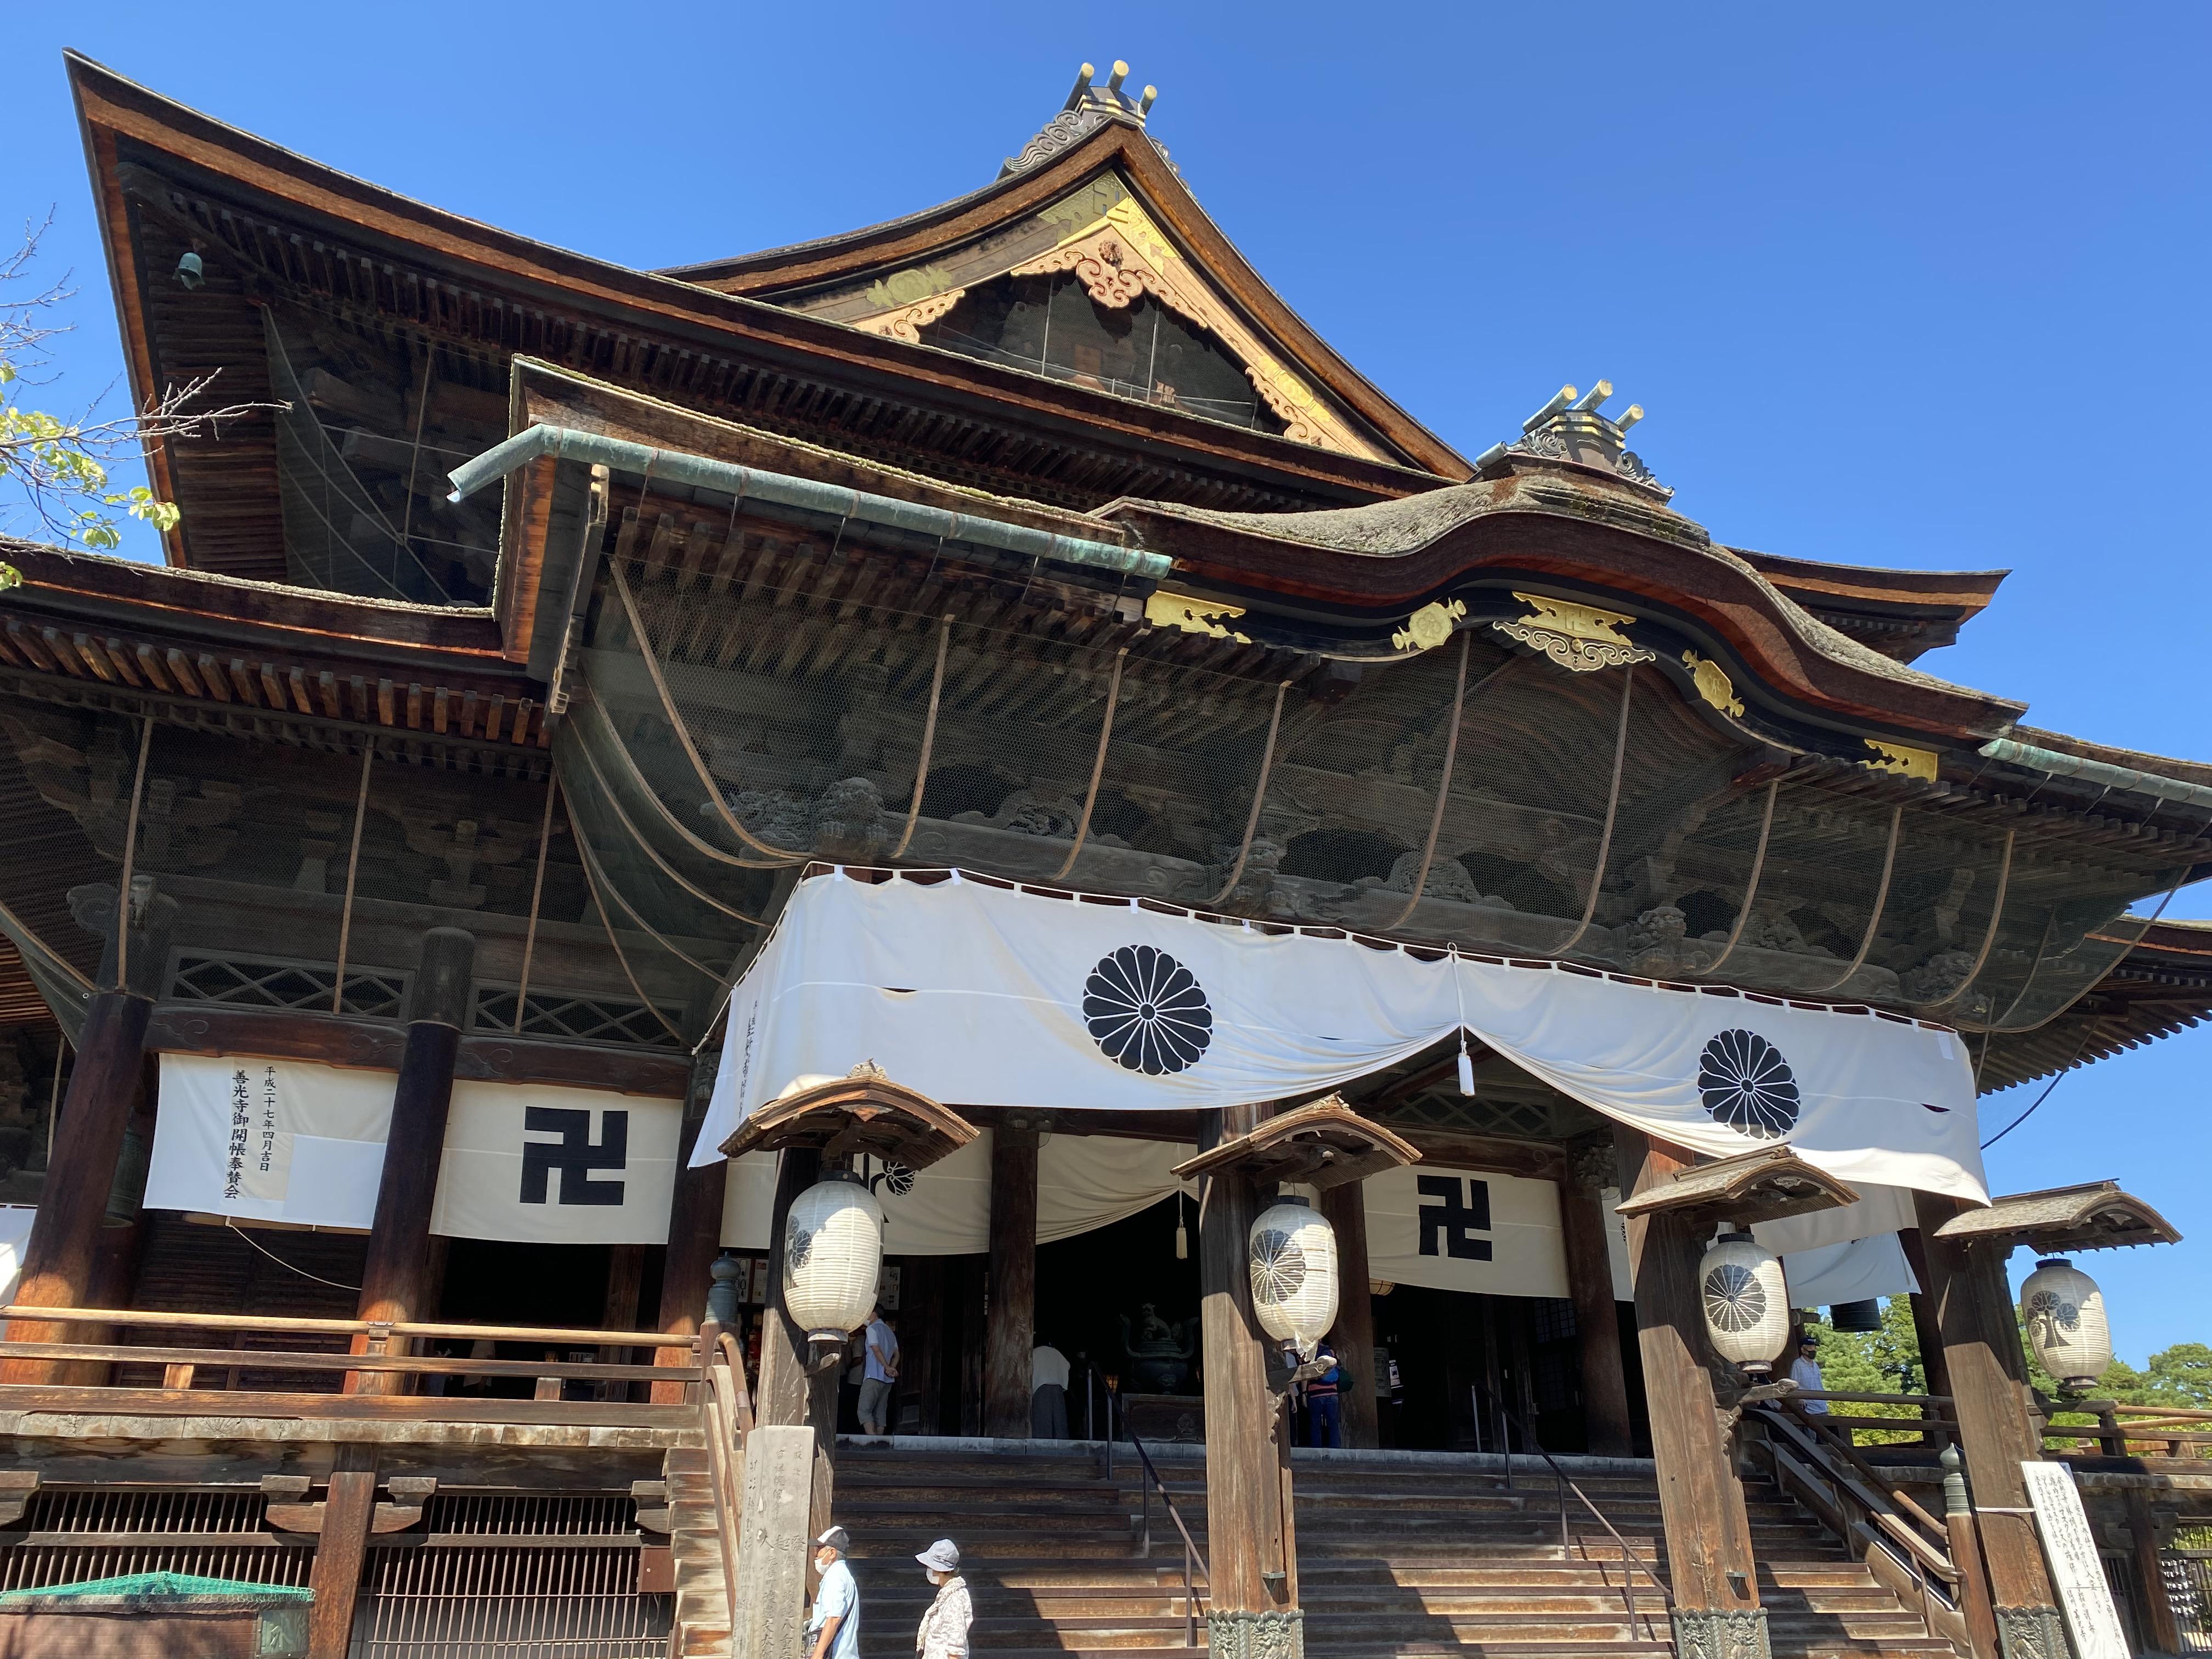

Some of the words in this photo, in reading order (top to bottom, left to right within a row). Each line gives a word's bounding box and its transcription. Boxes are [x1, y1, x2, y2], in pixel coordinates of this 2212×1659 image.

[223, 1070, 250, 1199] 善光寺御開帳奉賛会
[259, 1066, 276, 1172] 平成二十七年四月吉日
